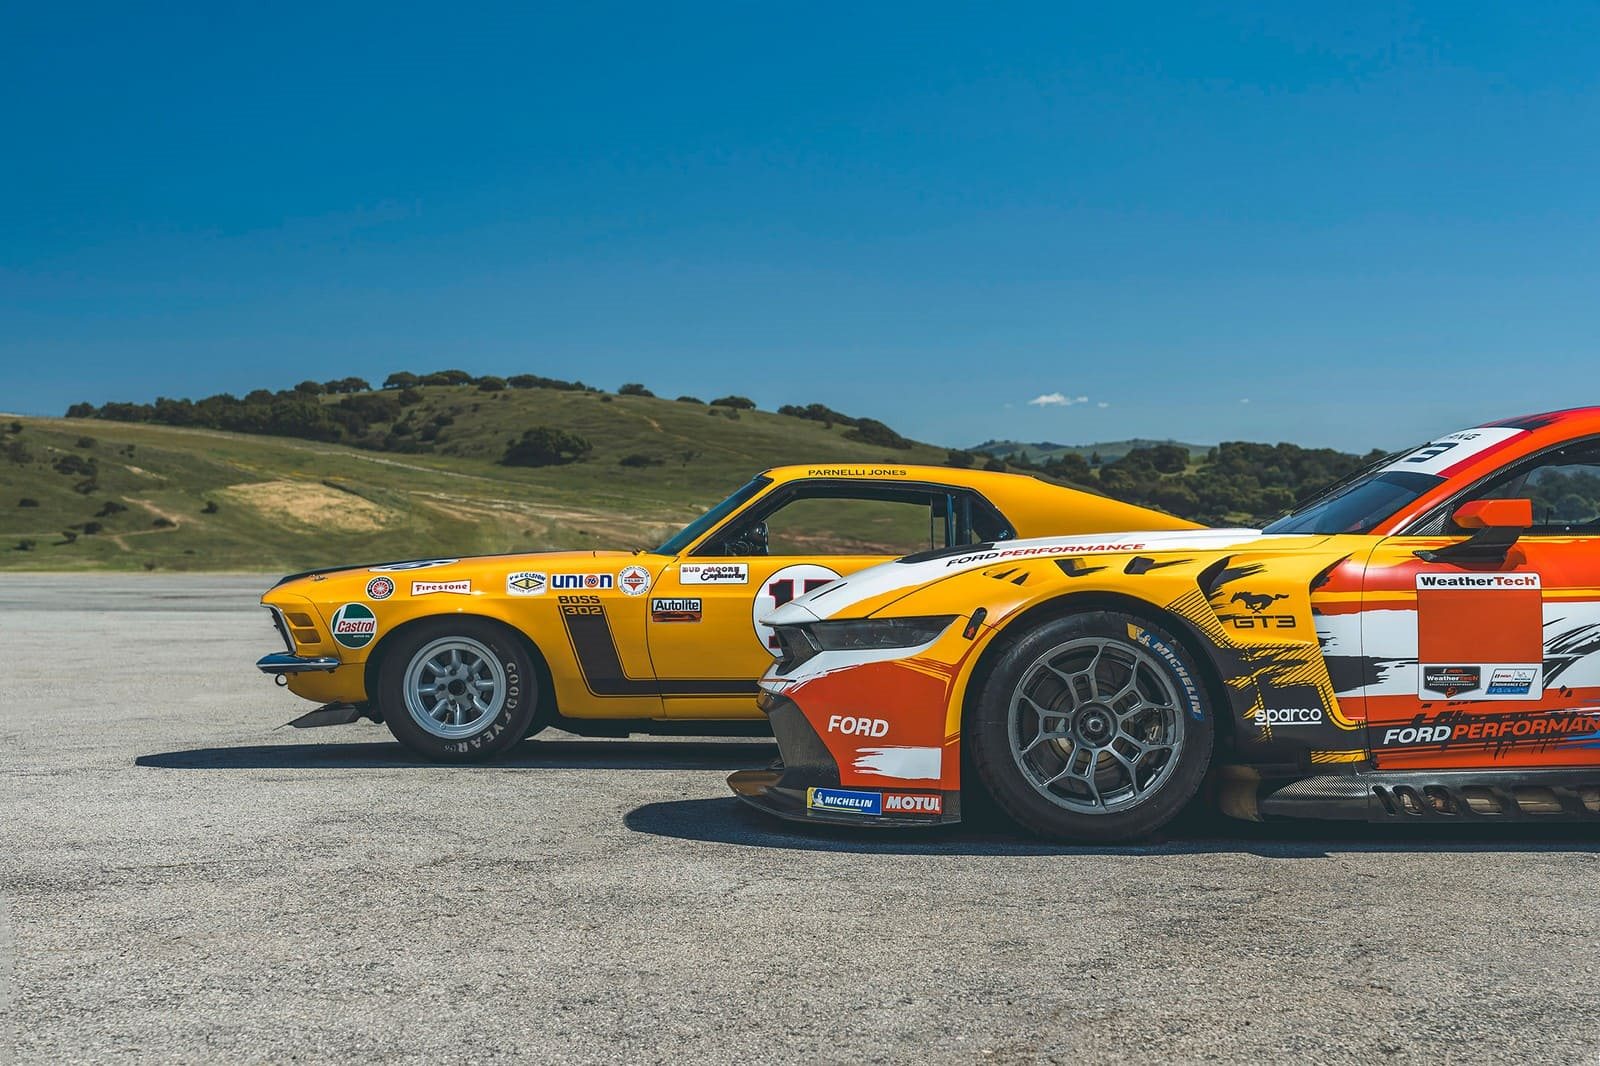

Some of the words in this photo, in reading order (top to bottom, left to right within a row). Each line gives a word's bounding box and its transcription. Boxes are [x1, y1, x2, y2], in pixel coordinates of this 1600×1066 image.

[414, 583, 468, 592] Firestone
[1420, 576, 1536, 587] WeatherTech
[558, 595, 601, 604] BOSS
[655, 600, 699, 611] Autolite
[564, 606, 603, 615] 302
[337, 620, 375, 633] Castrol
[1233, 615, 1297, 629] GT3
[1152, 641, 1202, 714] MICHELIN
[1254, 708, 1322, 728] sparco
[828, 715, 889, 738] FORD
[1383, 725, 1452, 745] FORD
[824, 796, 873, 808] MICHELIN
[885, 796, 940, 811] MOTUL
